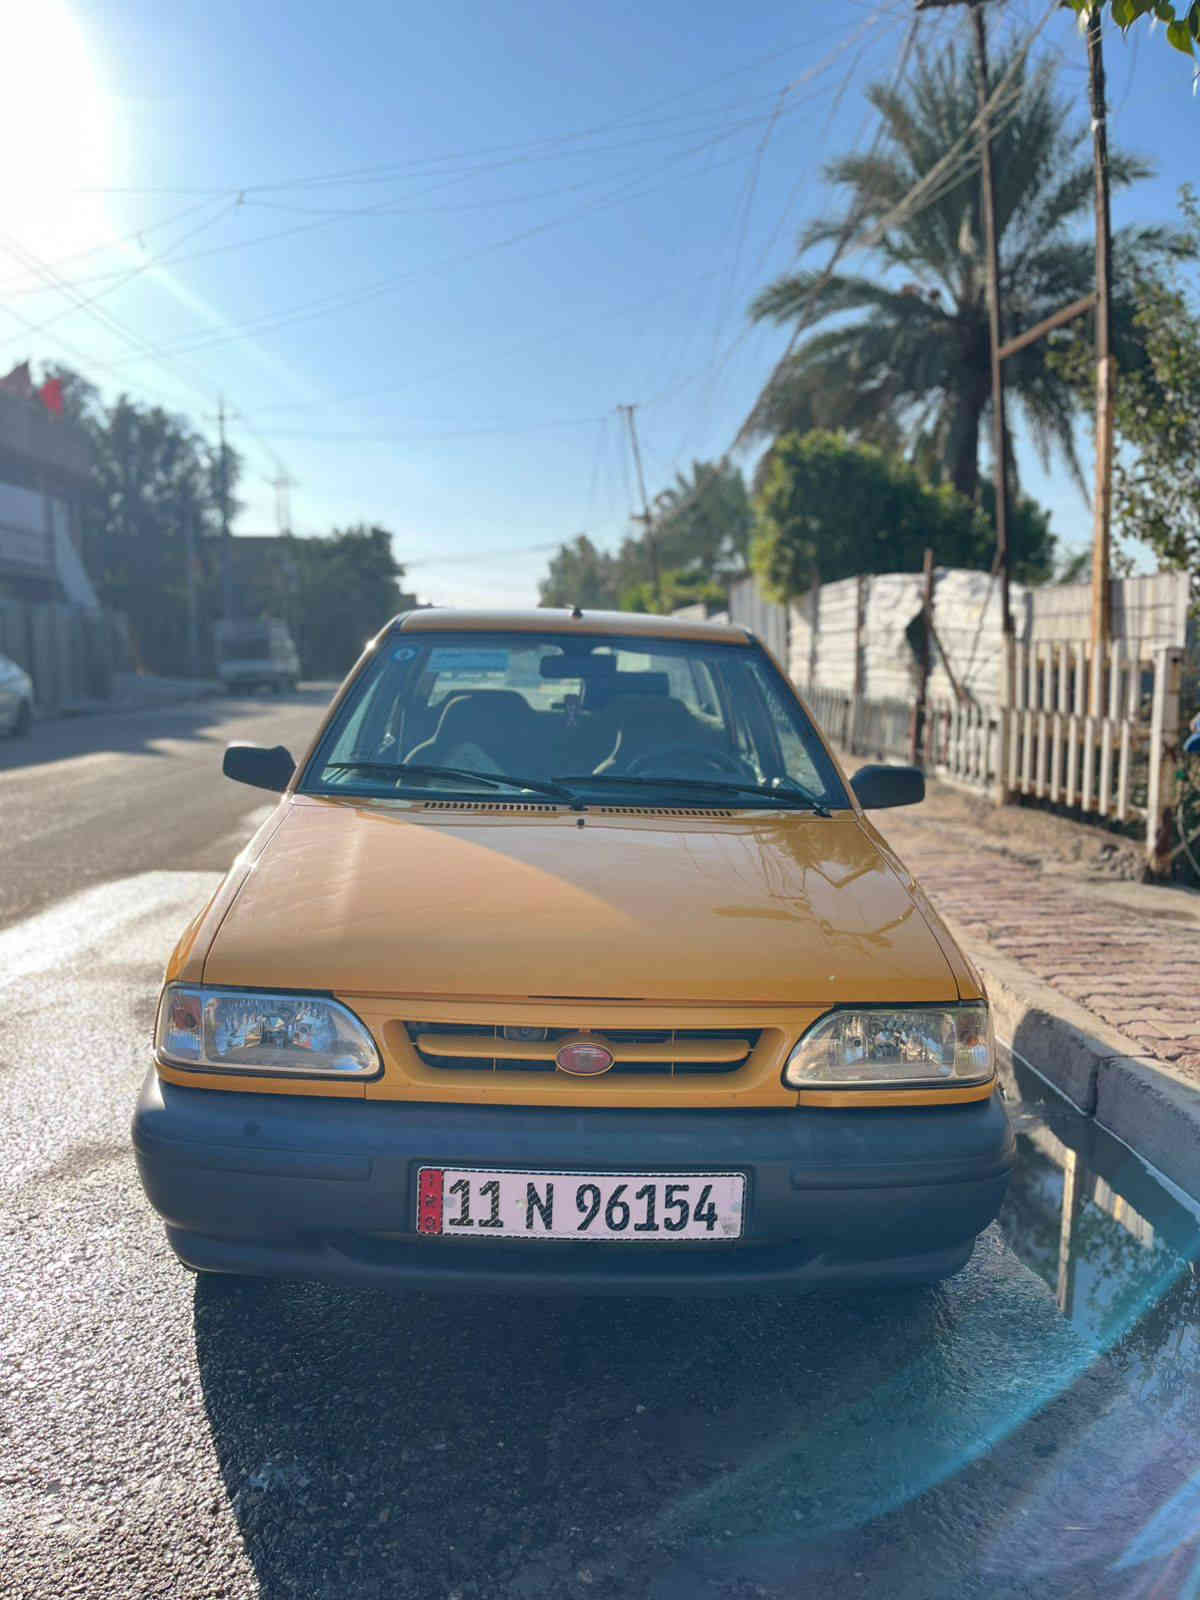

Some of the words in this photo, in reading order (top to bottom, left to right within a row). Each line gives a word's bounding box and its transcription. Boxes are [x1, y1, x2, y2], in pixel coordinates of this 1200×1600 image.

[449, 1179, 504, 1227] 11
[525, 1182, 554, 1230] N
[576, 1183, 718, 1232] 96154
